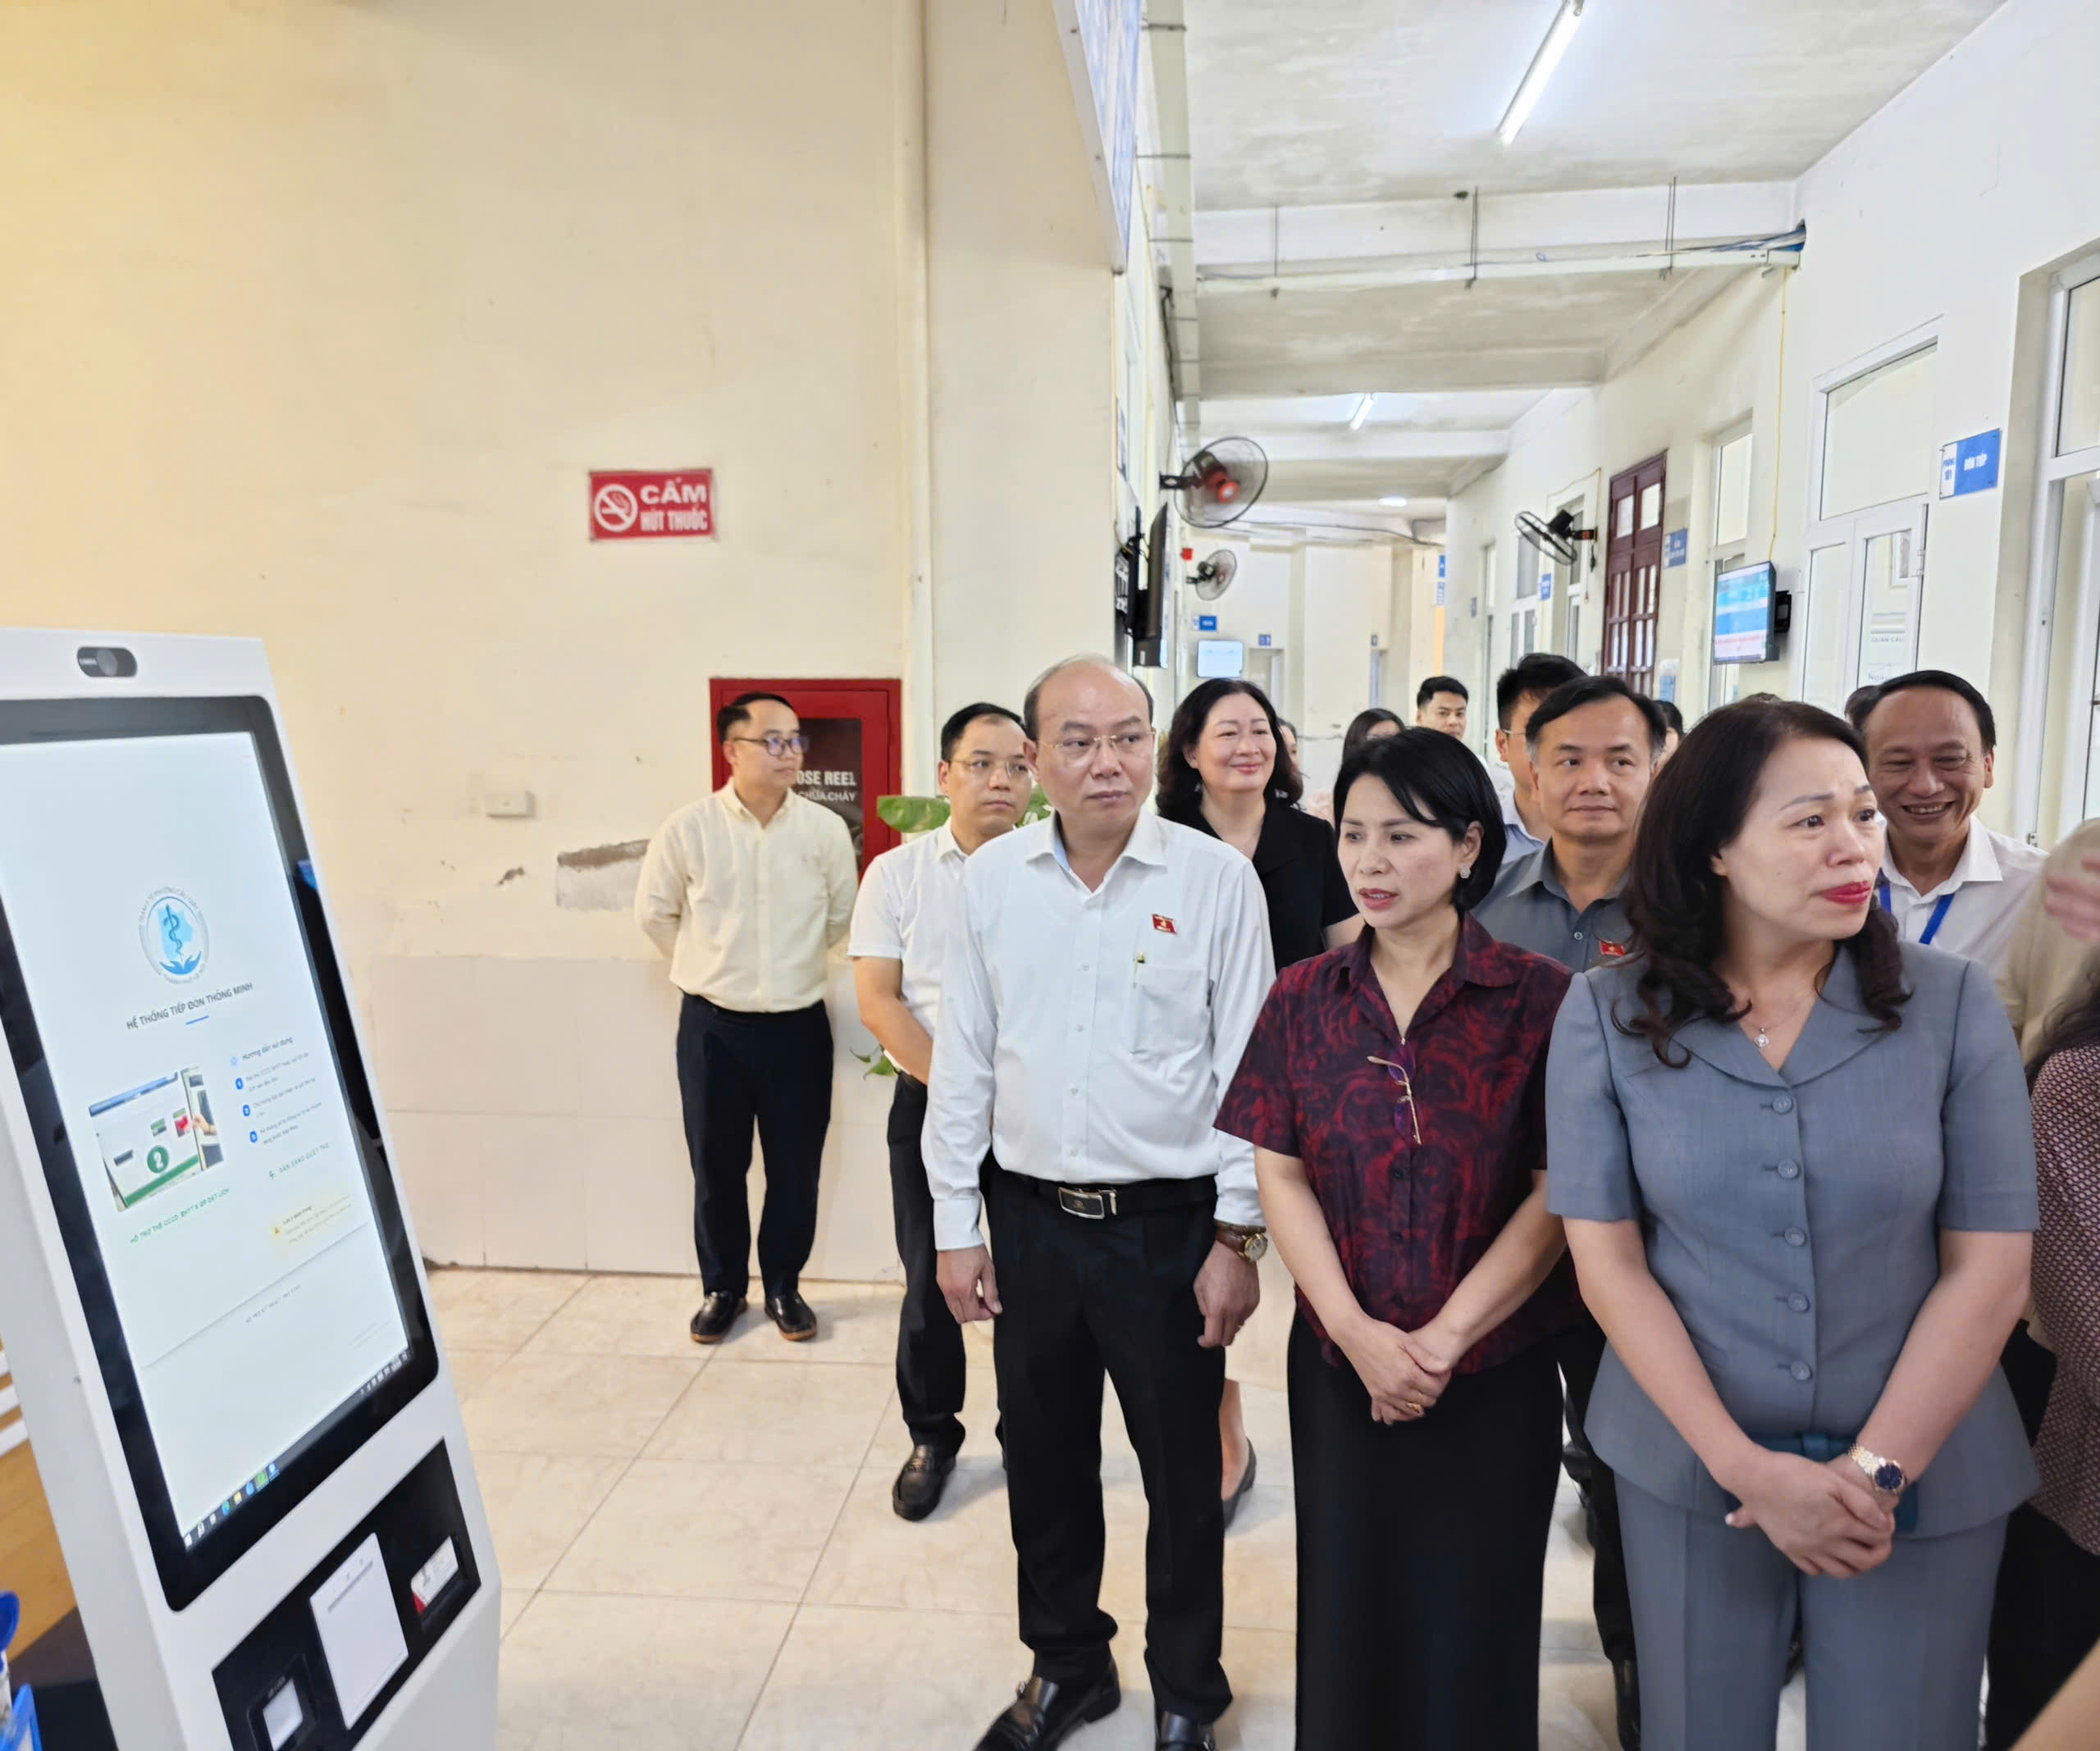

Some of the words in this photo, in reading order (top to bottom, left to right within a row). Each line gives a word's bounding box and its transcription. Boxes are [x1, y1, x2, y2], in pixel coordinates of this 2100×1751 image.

[640, 477, 707, 504] CẤM
[640, 506, 664, 531] HÚT
[667, 504, 708, 531] THUỐC
[797, 770, 822, 786] OSE
[824, 770, 856, 786] REEL
[170, 1001, 186, 1016] TIẾP
[233, 983, 253, 995] MINH
